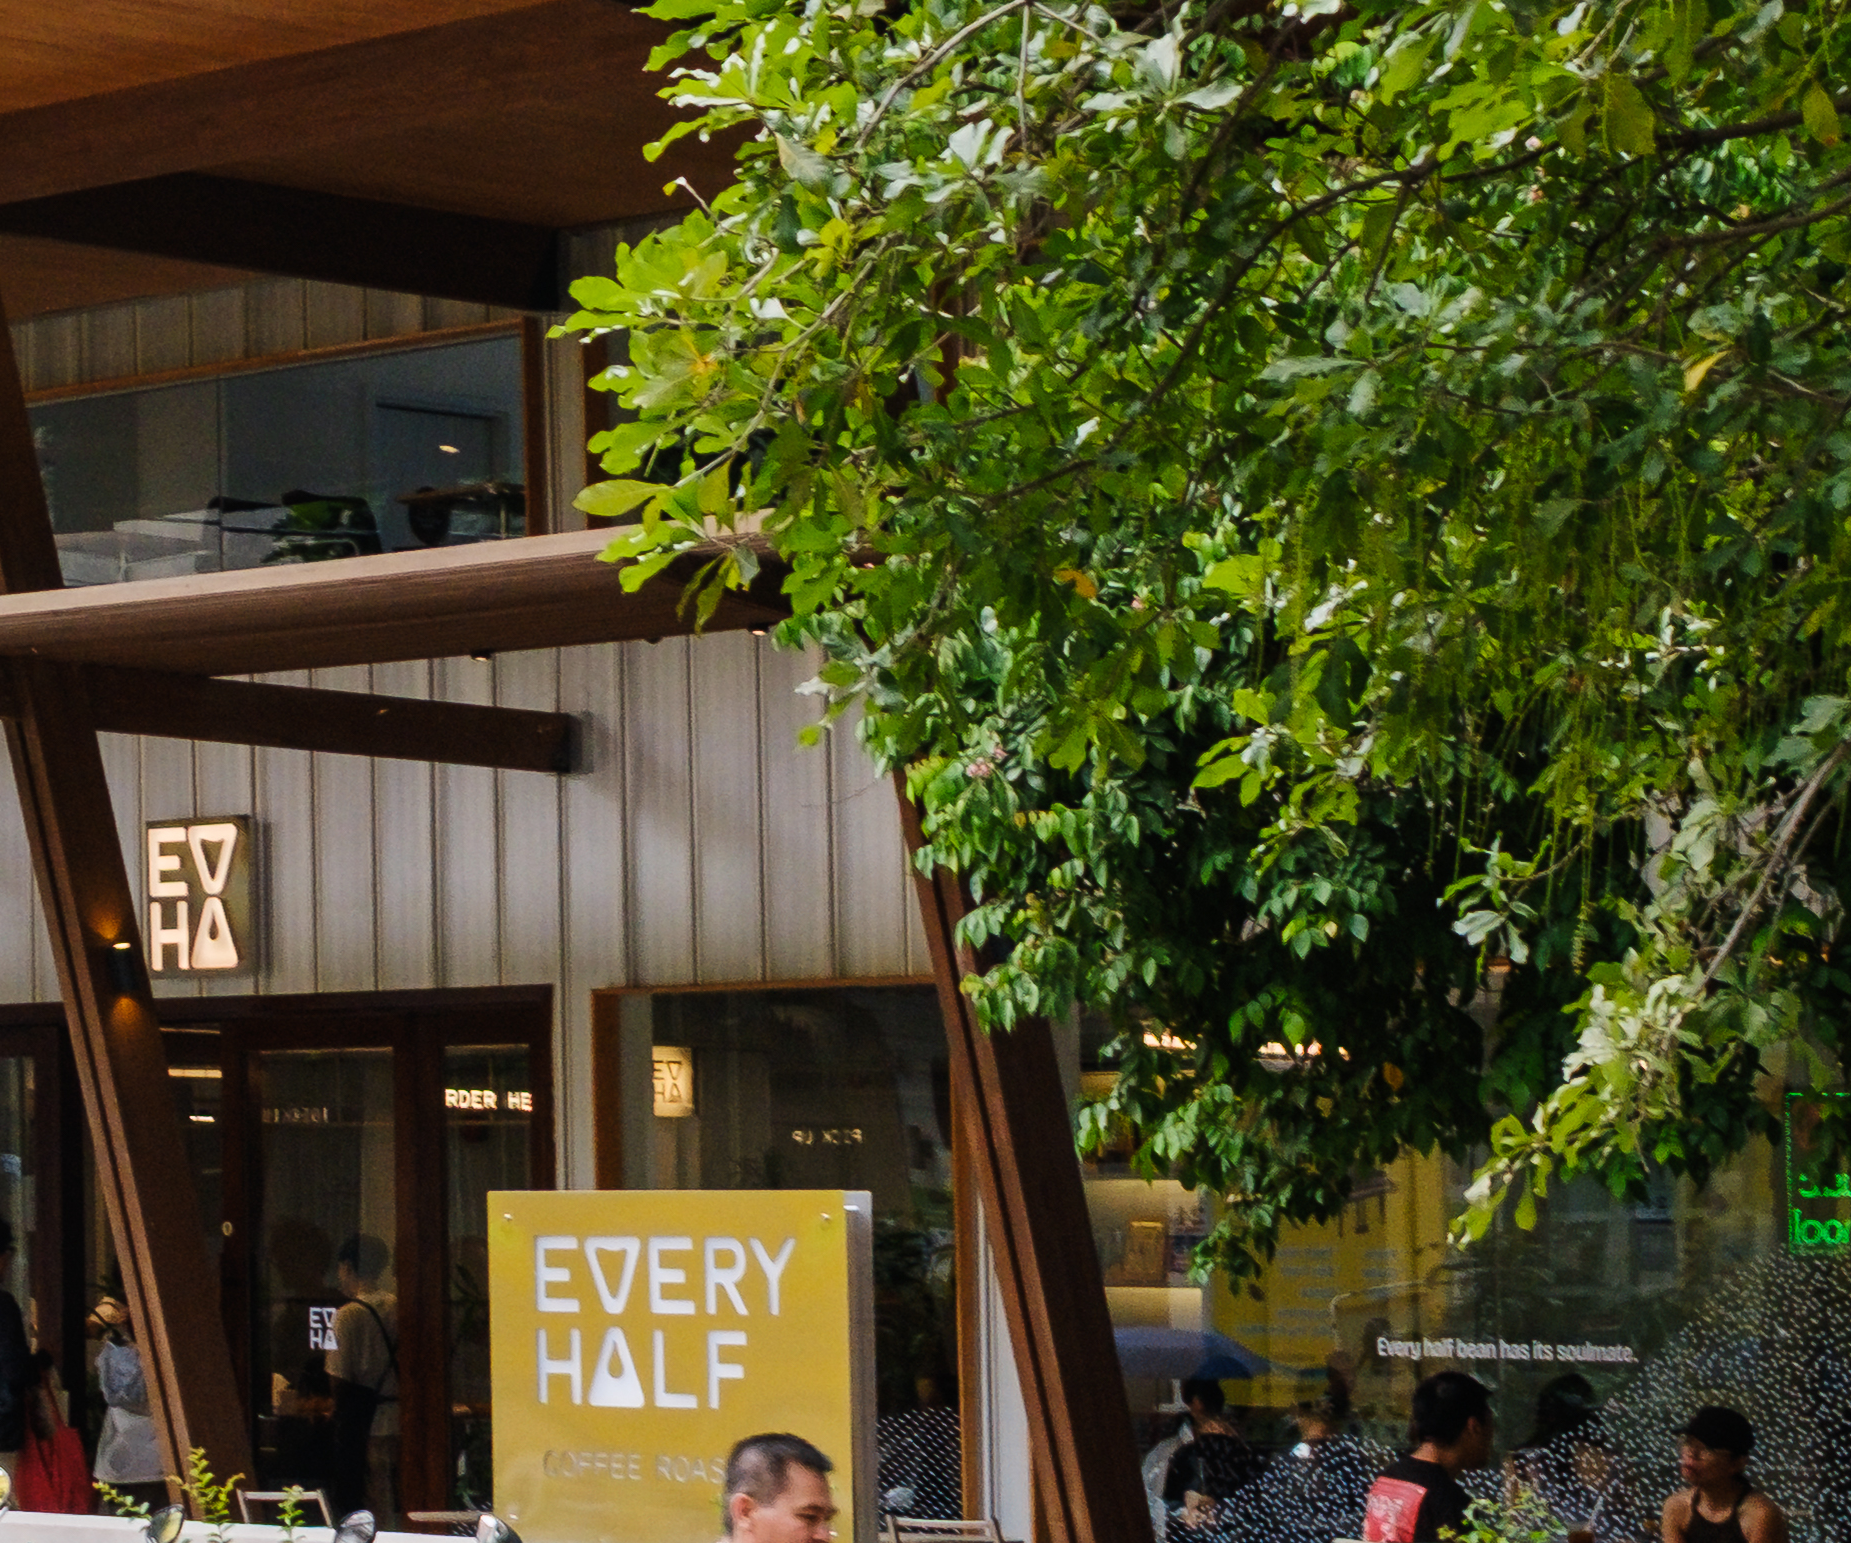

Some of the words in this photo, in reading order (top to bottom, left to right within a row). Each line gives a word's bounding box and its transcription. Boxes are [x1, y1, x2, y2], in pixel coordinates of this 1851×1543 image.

[445, 1088, 498, 1110] RDER
[507, 1091, 533, 1112] HE
[535, 1235, 796, 1316] EVERY
[1377, 1337, 1421, 1360] Every
[1455, 1338, 1497, 1359] bean
[1499, 1338, 1530, 1360] has
[1532, 1339, 1554, 1361] its
[536, 1326, 748, 1410] HALF
[543, 1449, 642, 1480] COFFEE
[655, 1455, 726, 1485] ROAS
